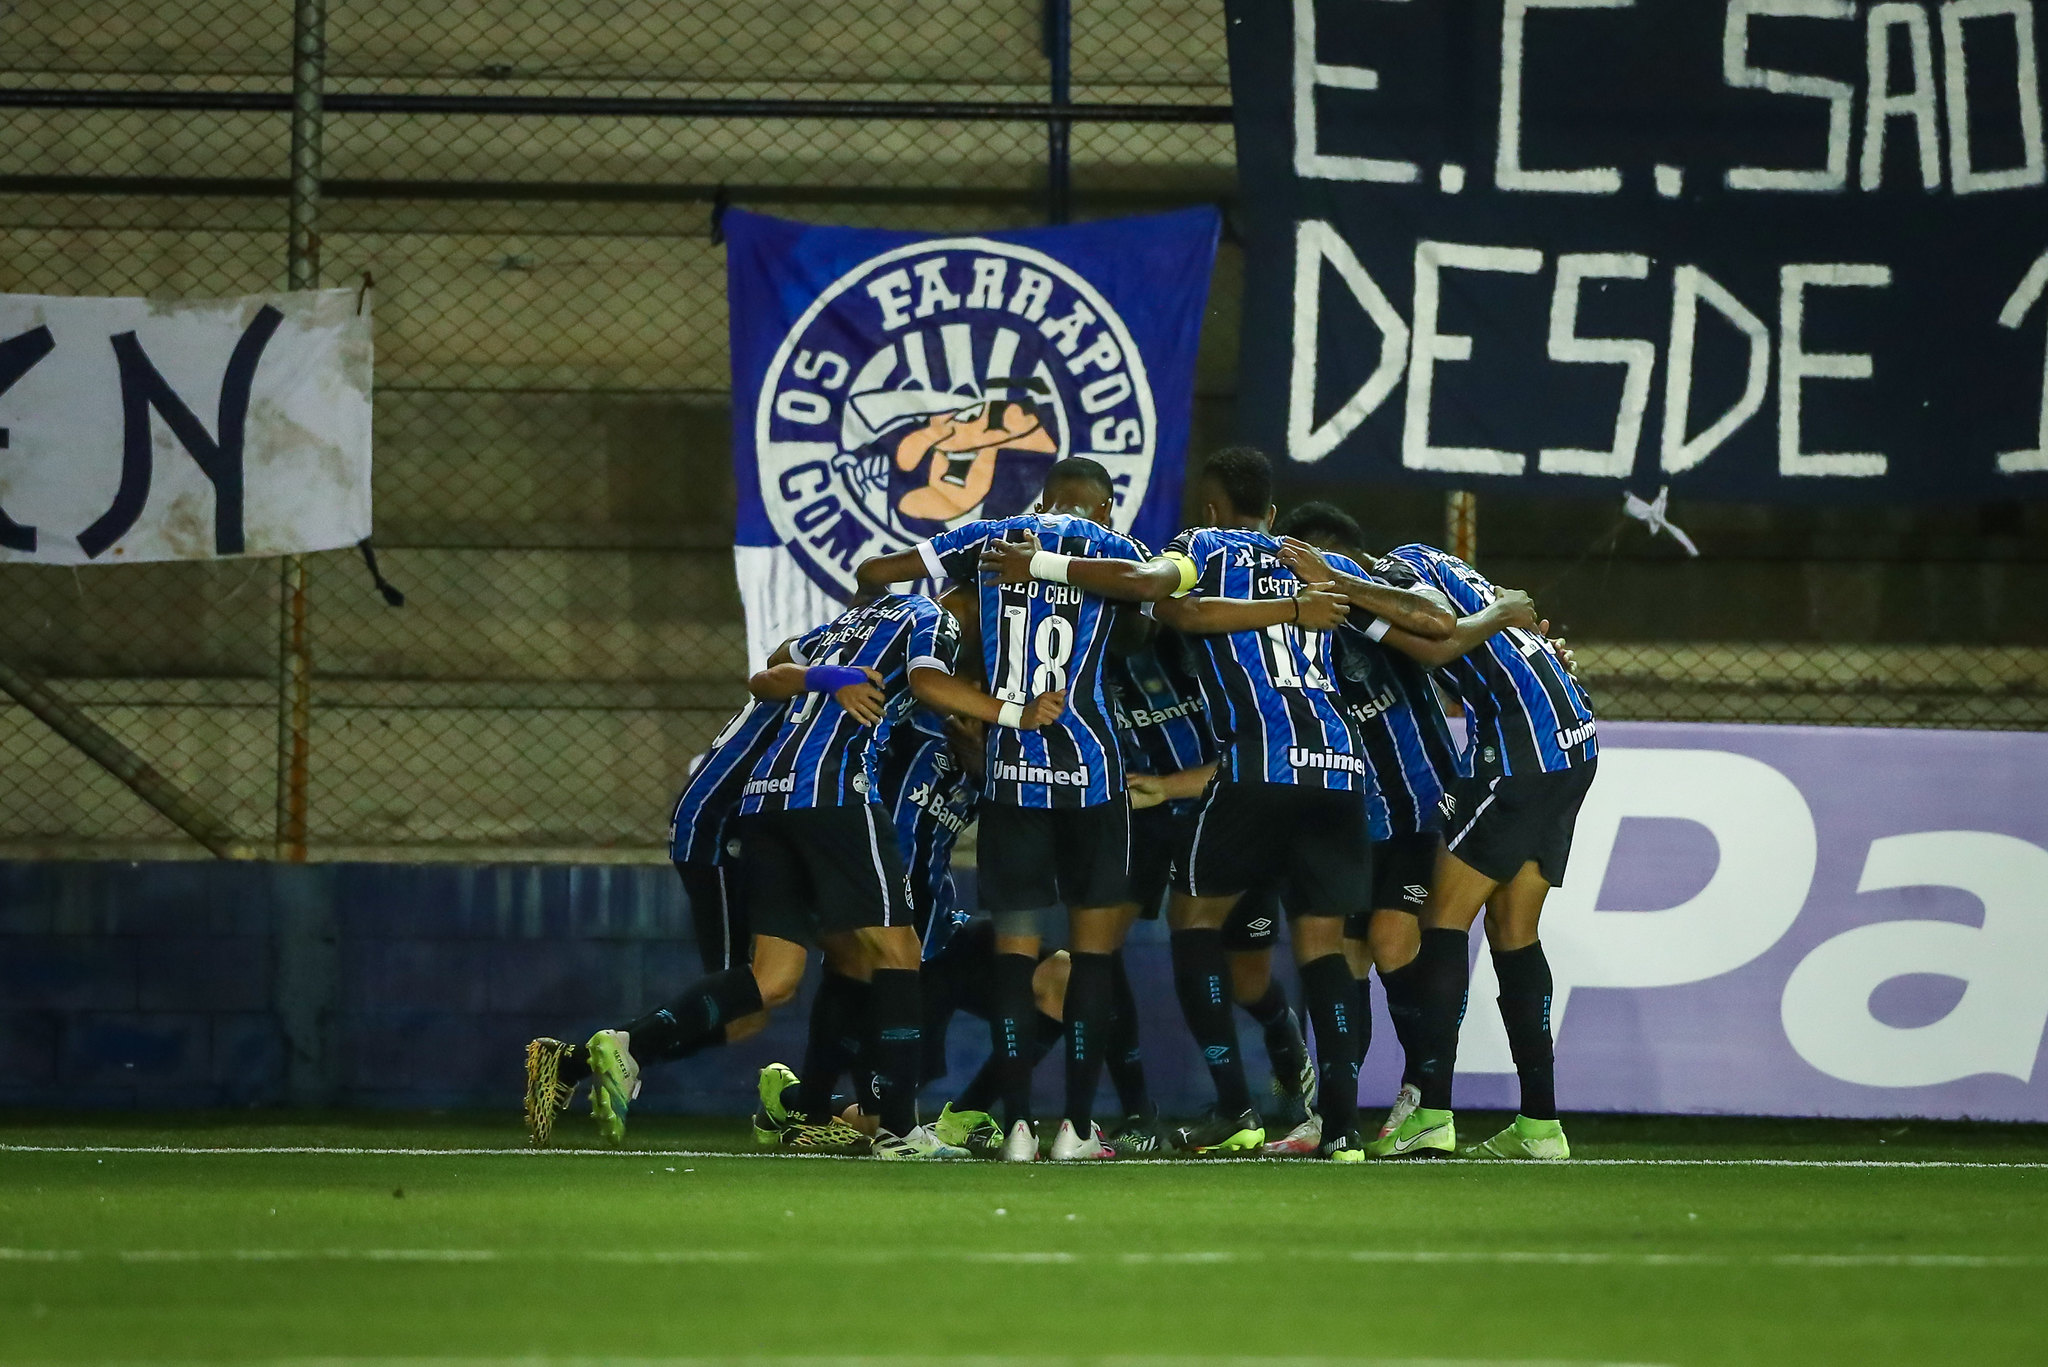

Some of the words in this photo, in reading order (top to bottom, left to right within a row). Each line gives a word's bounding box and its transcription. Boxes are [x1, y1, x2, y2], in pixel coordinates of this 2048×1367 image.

[777, 349, 851, 425] OS
[866, 256, 1143, 454] FARRAPOS
[1288, 219, 1892, 479] DESDE
[996, 605, 1074, 705] 18
[1289, 748, 1366, 777] Unime
[1556, 720, 1596, 750] Unim
[743, 772, 796, 798] imed
[993, 760, 1089, 786] Unimed
[1453, 747, 2048, 1088] Pa
